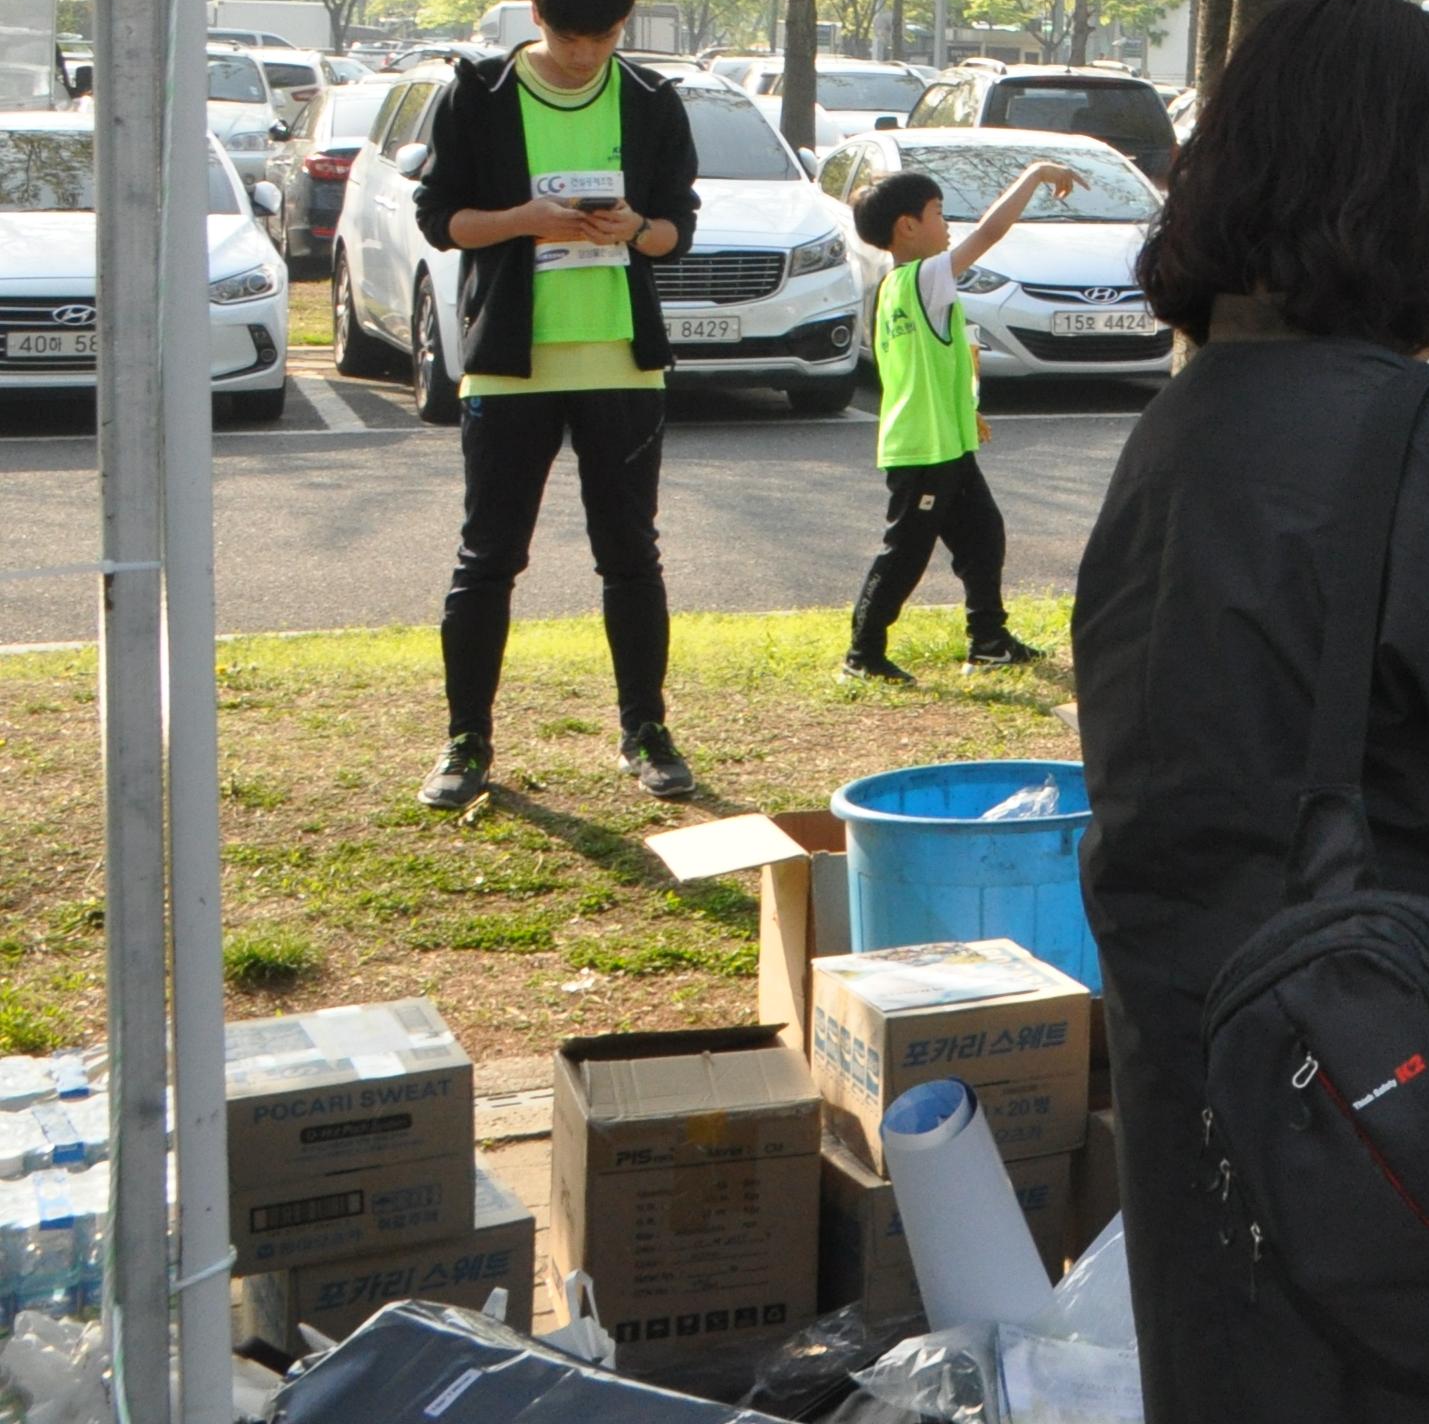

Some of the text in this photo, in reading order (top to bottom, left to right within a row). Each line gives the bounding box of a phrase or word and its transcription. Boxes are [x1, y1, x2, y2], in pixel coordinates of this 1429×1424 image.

[681, 320, 729, 338] 8429
[1104, 314, 1146, 330] 4424
[902, 1021, 1068, 1068] 포카리 스웨트
[254, 1079, 452, 1124] POCARI SWEAT
[314, 1267, 416, 1311] 포카리
